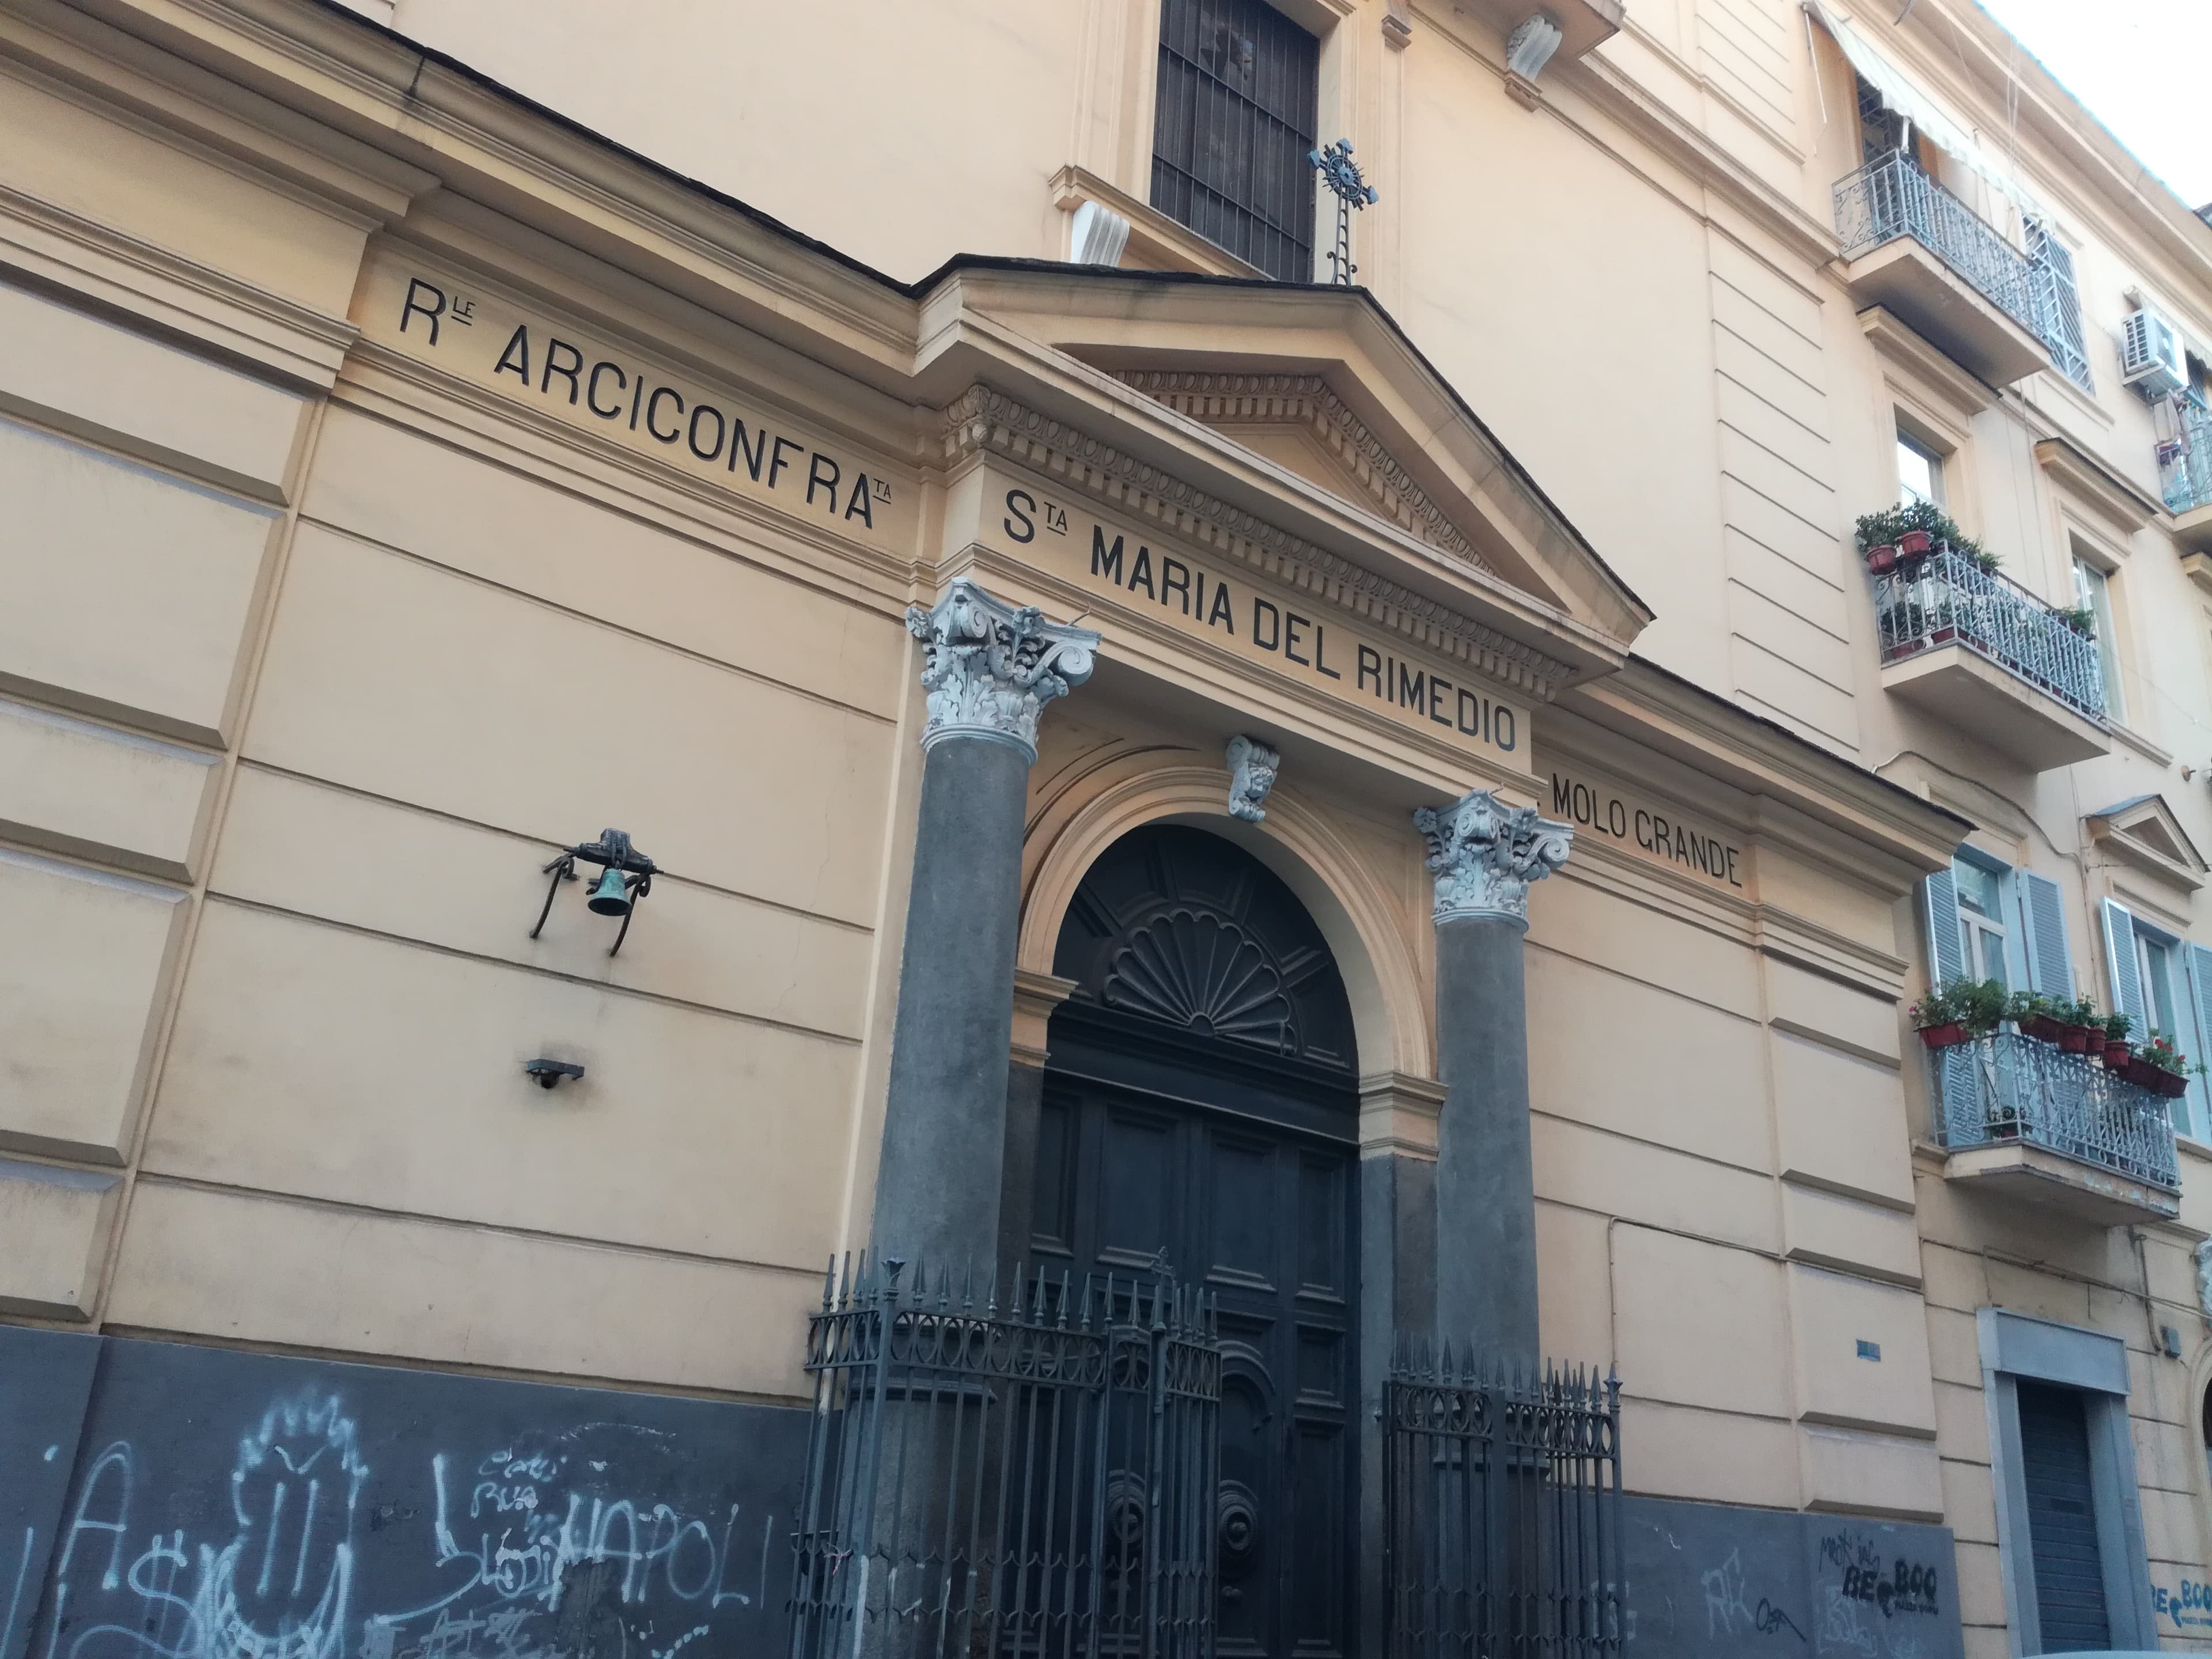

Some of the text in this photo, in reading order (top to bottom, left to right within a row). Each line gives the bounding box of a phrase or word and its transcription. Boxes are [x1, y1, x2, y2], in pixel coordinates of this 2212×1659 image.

[1090, 524, 1235, 636] MARIA
[1252, 596, 1342, 681] DEL
[1357, 643, 1516, 752] RIMEDIO
[1552, 772, 1743, 889] MOLO GRANDE
